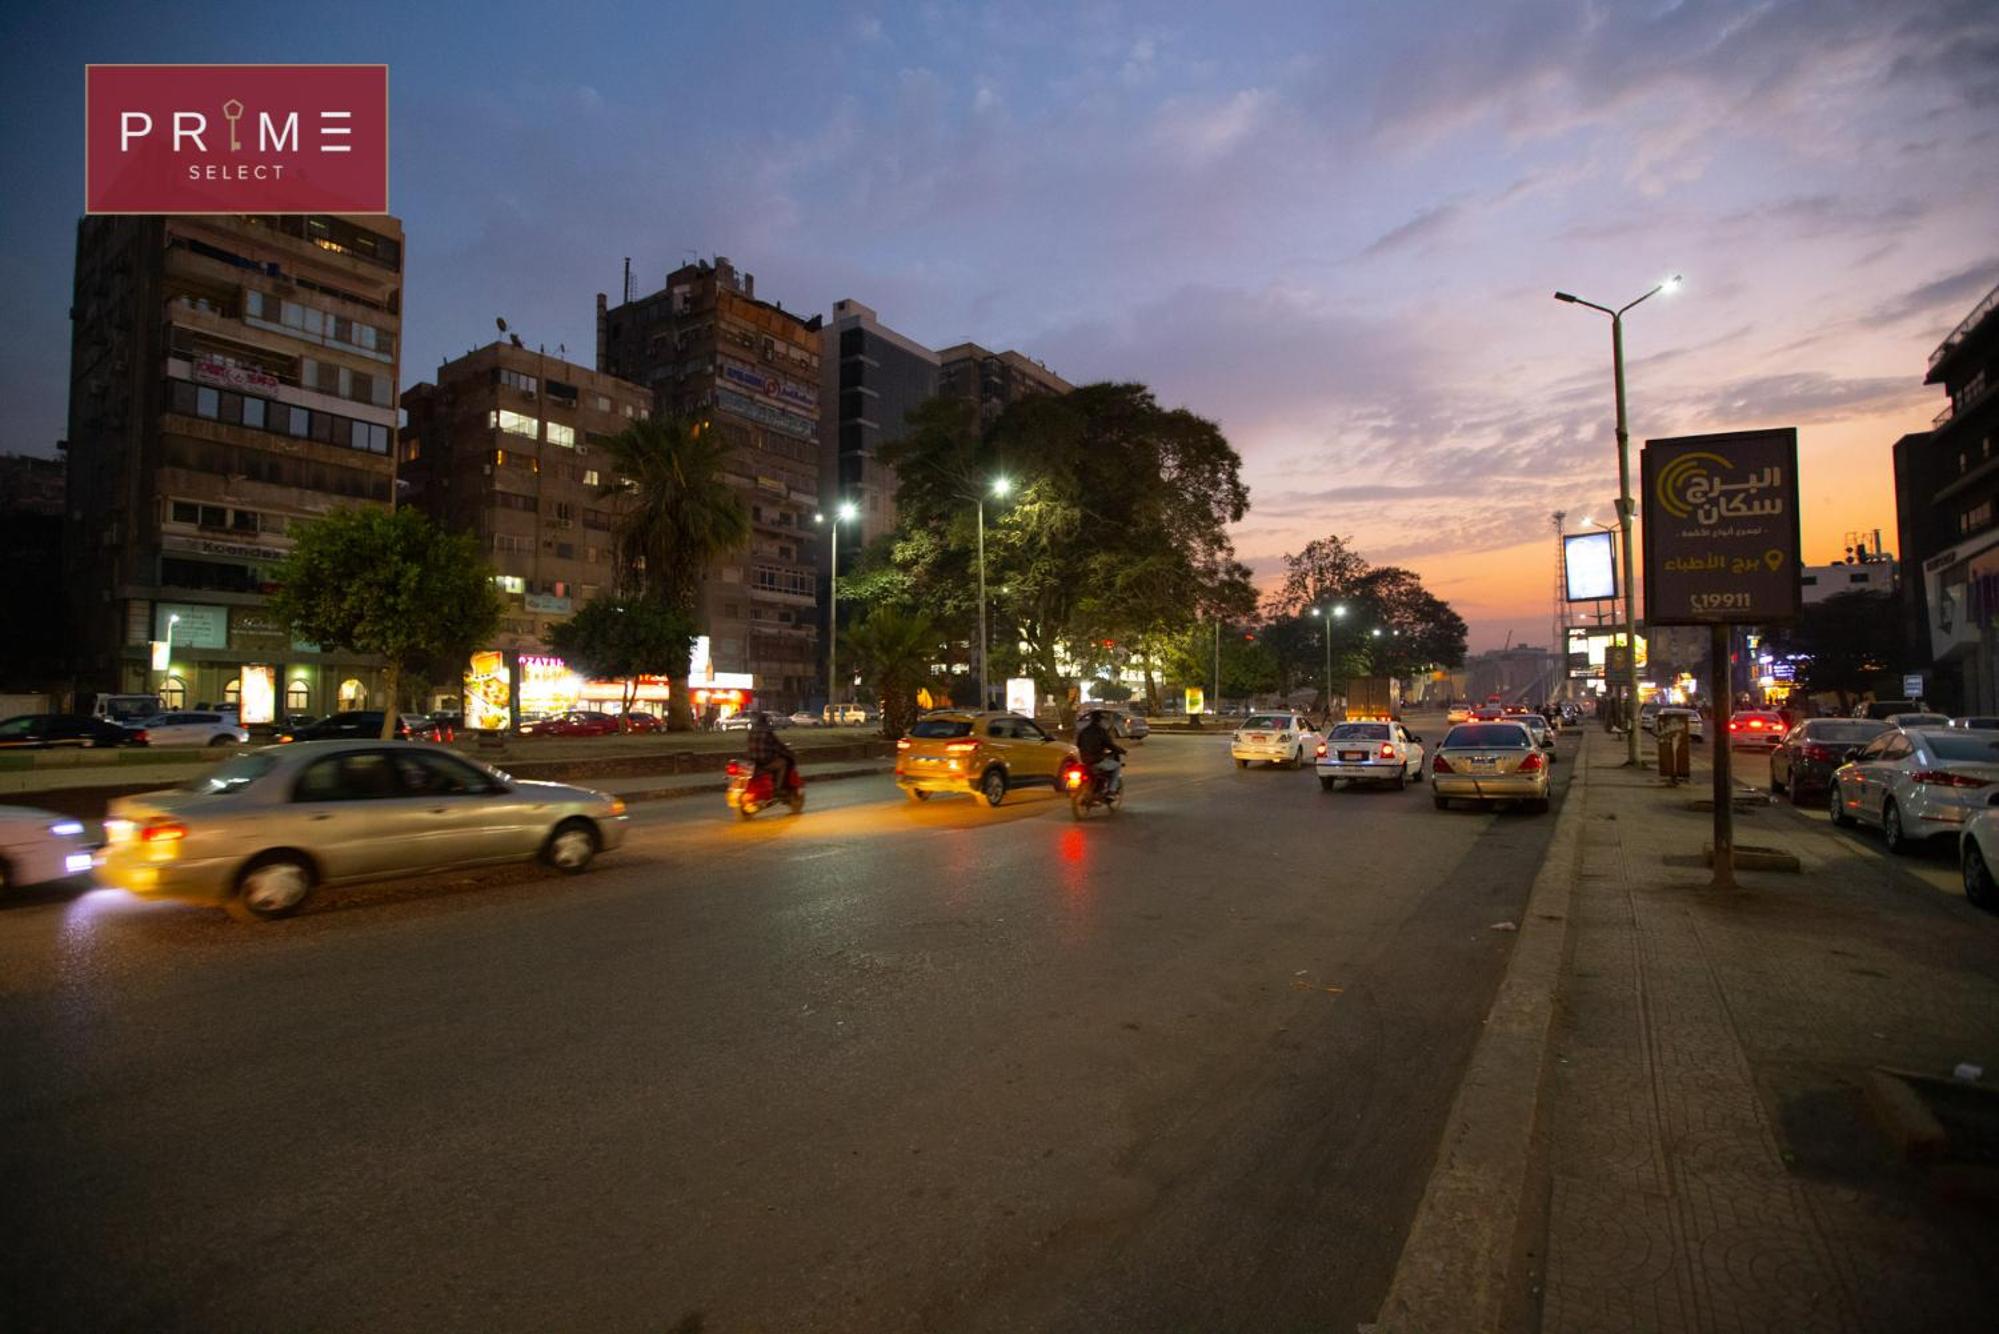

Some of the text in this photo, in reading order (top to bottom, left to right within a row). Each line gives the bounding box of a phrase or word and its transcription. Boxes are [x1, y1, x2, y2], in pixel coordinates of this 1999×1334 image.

[1686, 466, 1782, 503] البرج
[1697, 493, 1783, 525] سكان
[1731, 556, 1760, 574] برج
[1701, 593, 1750, 608] 19911
